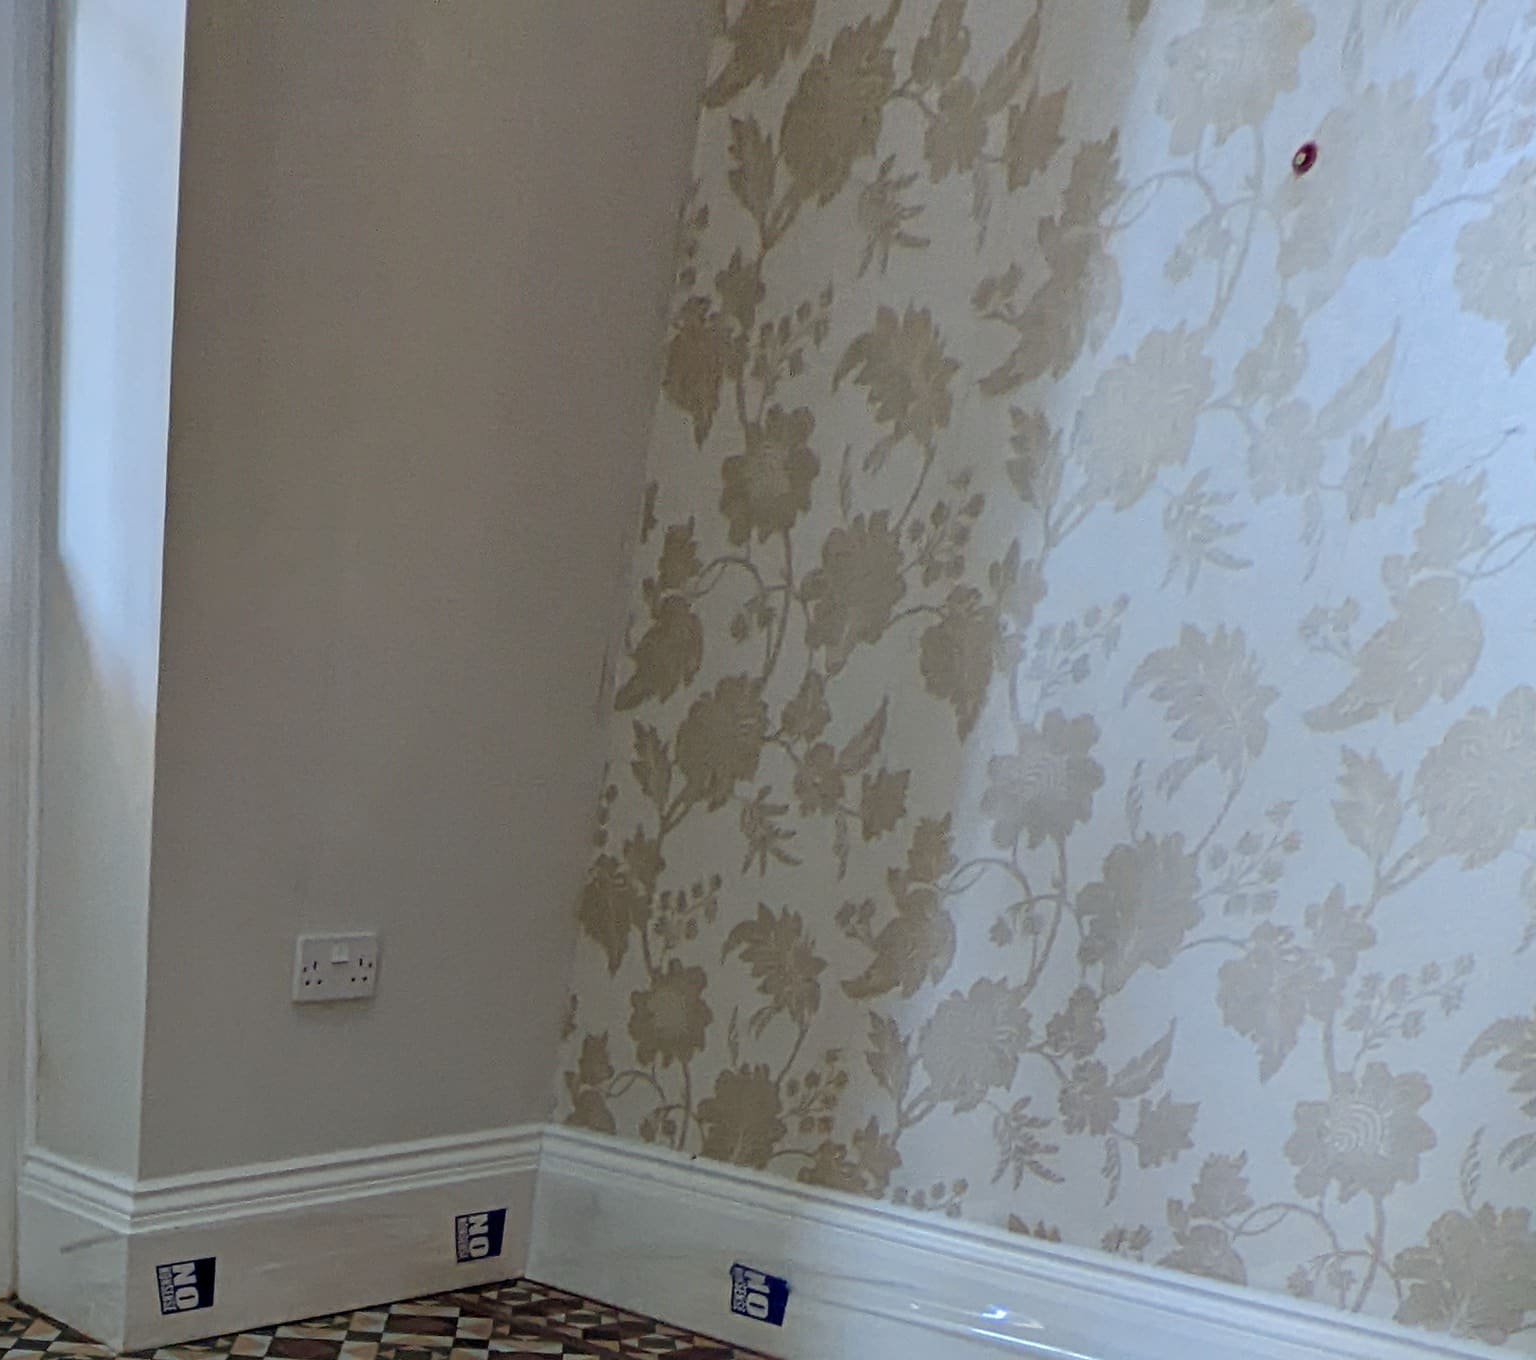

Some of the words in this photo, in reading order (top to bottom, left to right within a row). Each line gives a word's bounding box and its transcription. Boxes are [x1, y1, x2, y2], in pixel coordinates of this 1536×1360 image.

[468, 1213, 489, 1258] NO
[172, 1262, 199, 1310] NO
[744, 1270, 770, 1319] NO
